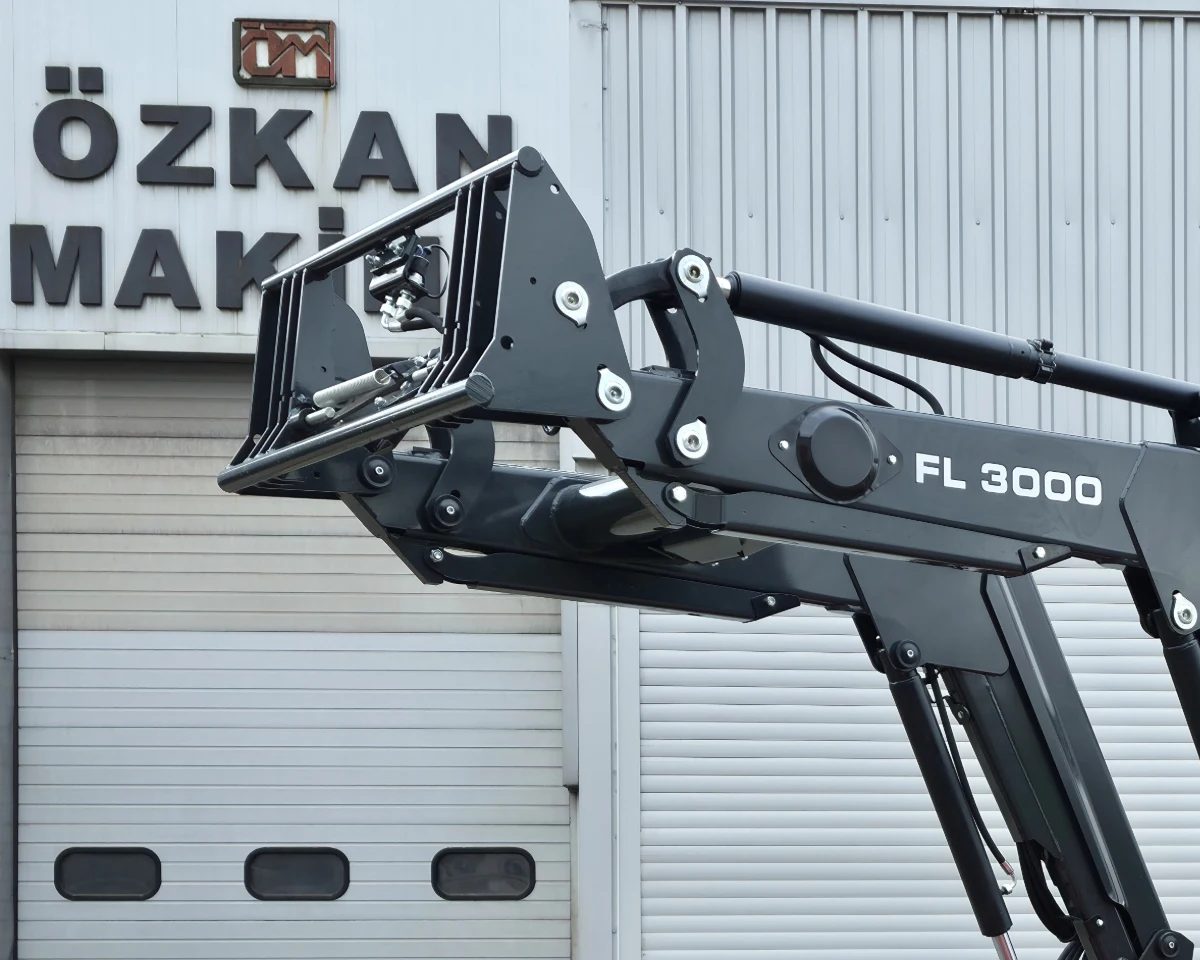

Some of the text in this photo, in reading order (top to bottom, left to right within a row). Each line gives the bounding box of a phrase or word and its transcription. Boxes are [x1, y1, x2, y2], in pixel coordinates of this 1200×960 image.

[32, 66, 512, 192] ÖZKAN
[915, 452, 1103, 507] FL 3000
